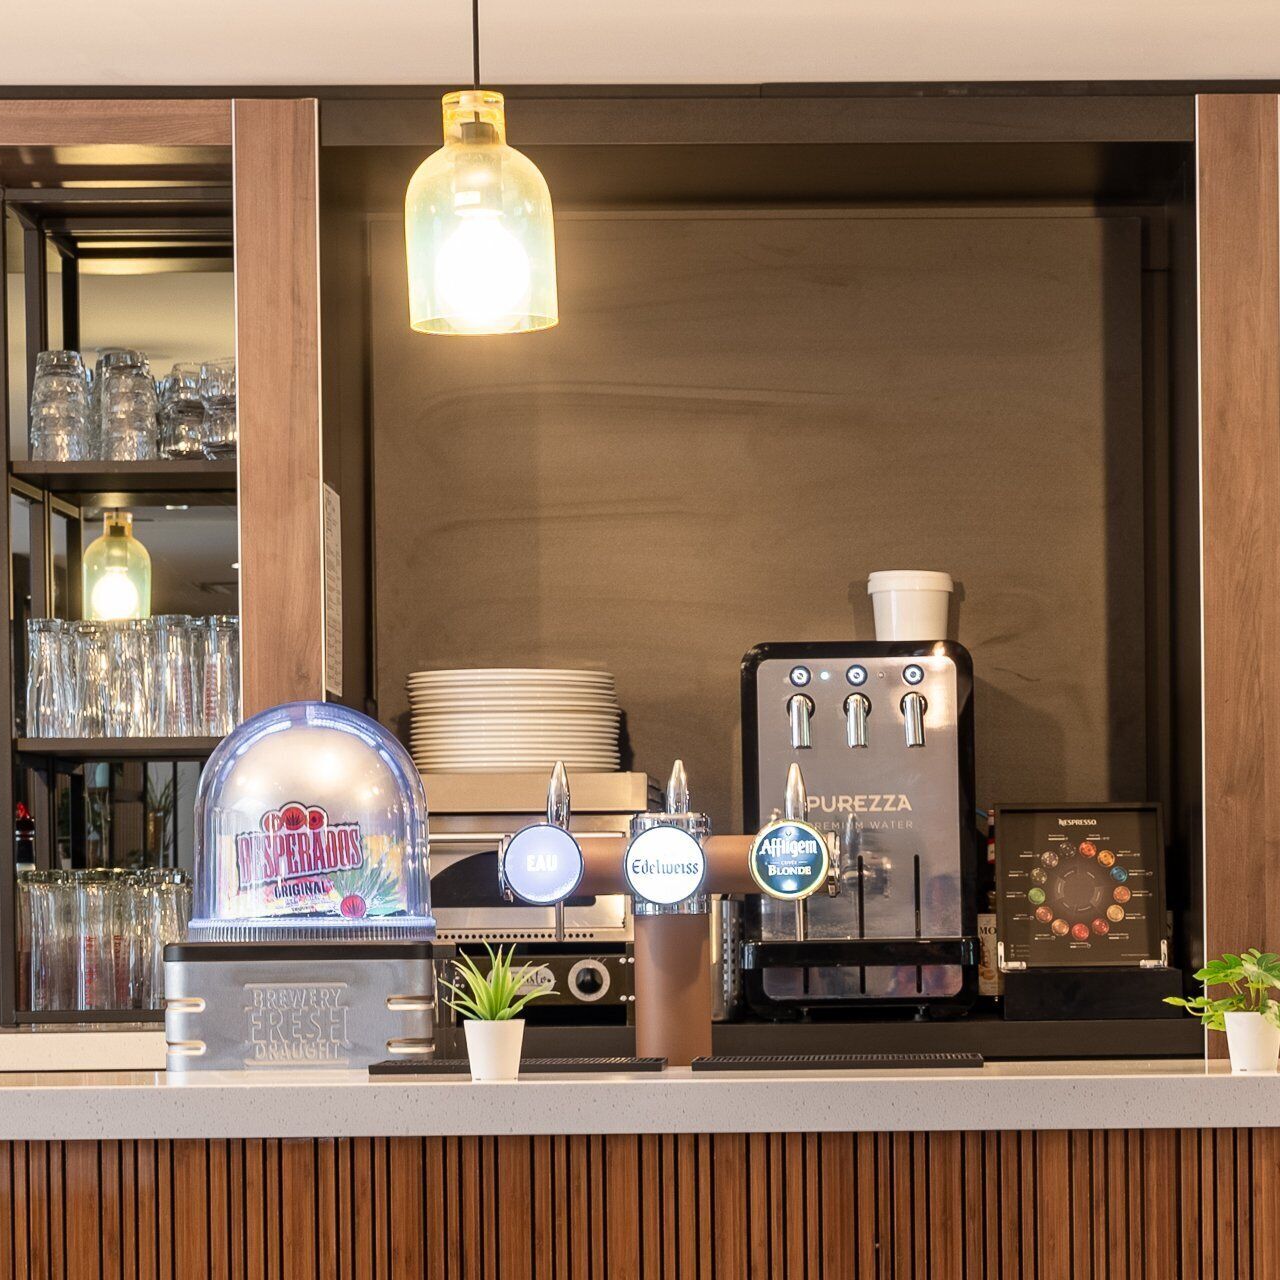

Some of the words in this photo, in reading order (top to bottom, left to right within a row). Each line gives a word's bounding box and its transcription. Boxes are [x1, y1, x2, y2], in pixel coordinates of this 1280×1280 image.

[807, 794, 913, 813] PUREZZA
[870, 820, 913, 830] WATER
[1057, 818, 1098, 827] NESPRESSO
[238, 829, 362, 884] DESPERADOS
[758, 837, 818, 858] Affligem
[526, 854, 558, 872] EAU
[631, 858, 700, 877] Edelweiss
[767, 864, 812, 876] BLONDE
[274, 881, 328, 899] ORIGINAL
[253, 988, 341, 1010] BREWERY
[250, 1007, 349, 1043] FRESH
[254, 1042, 340, 1060] DRAUGHT
